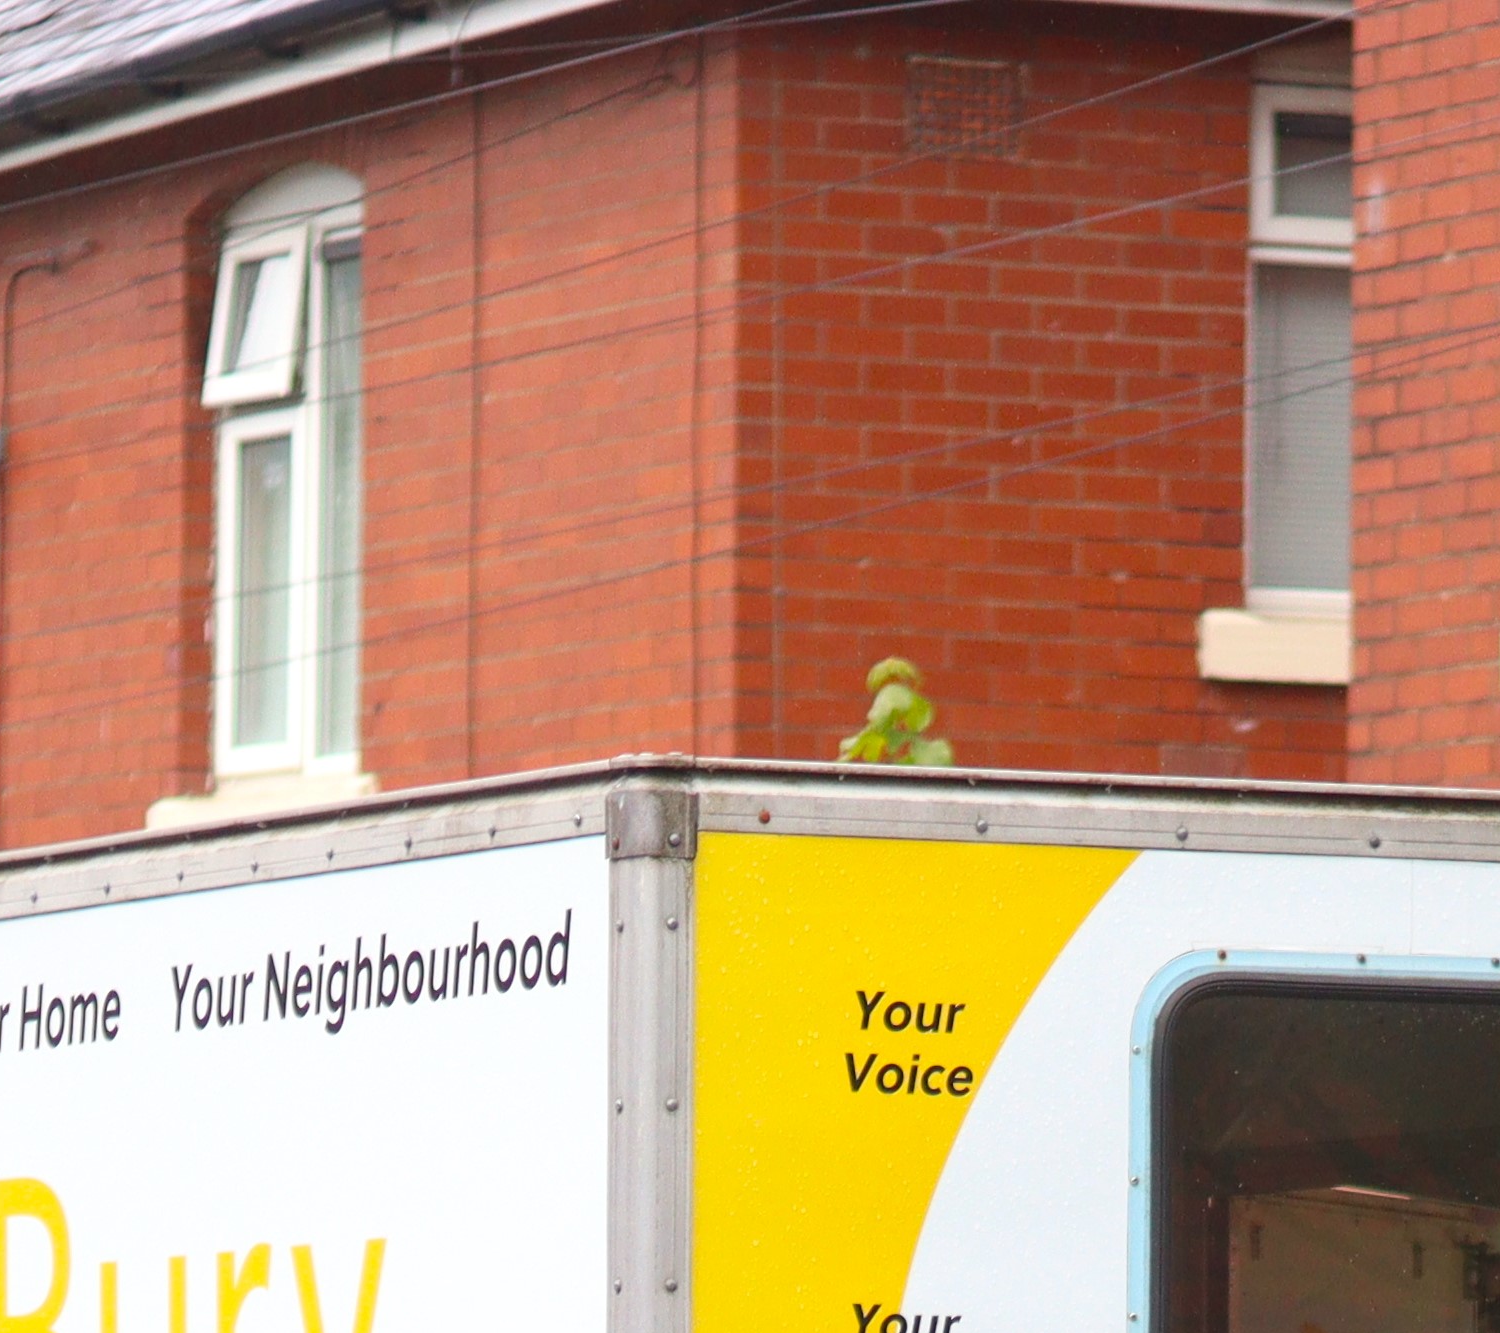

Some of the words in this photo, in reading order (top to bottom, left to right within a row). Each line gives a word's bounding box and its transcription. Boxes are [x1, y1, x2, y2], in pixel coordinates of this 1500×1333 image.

[20, 985, 120, 1049] Home
[173, 965, 253, 1031] Your
[264, 909, 571, 1034] Neighbourhood
[857, 991, 965, 1033] Your
[846, 1054, 973, 1096] Voice
